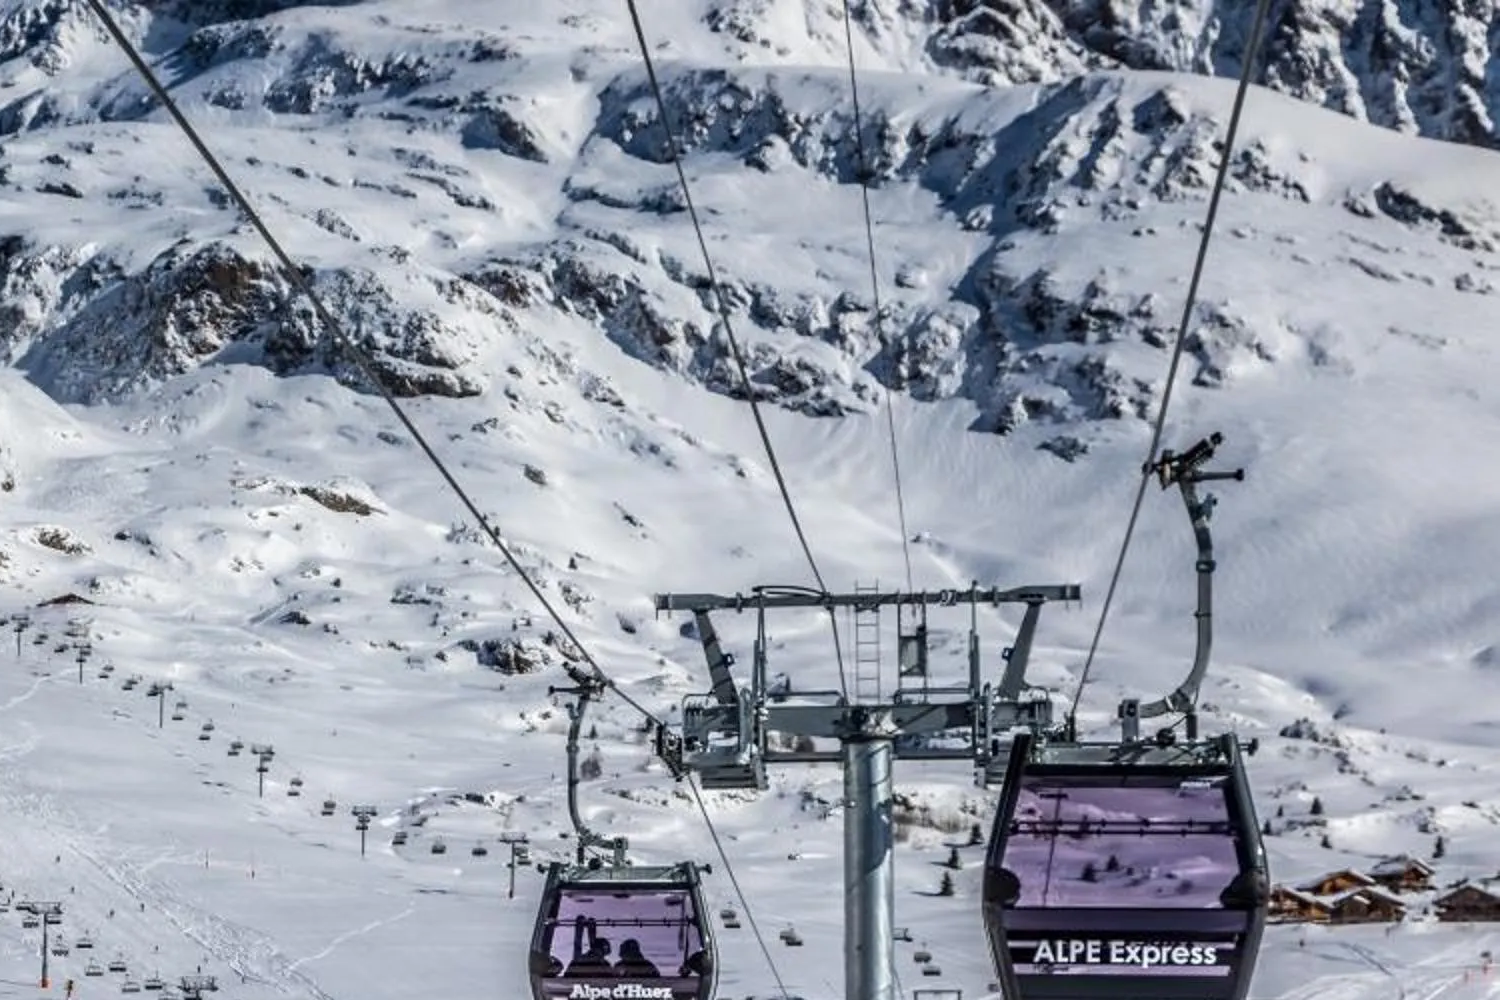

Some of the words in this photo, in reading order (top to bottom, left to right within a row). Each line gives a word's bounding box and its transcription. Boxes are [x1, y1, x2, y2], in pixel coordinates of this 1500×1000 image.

[1033, 939, 1101, 963] ALPE
[1109, 940, 1218, 969] Express
[612, 983, 673, 999] d'Huez
